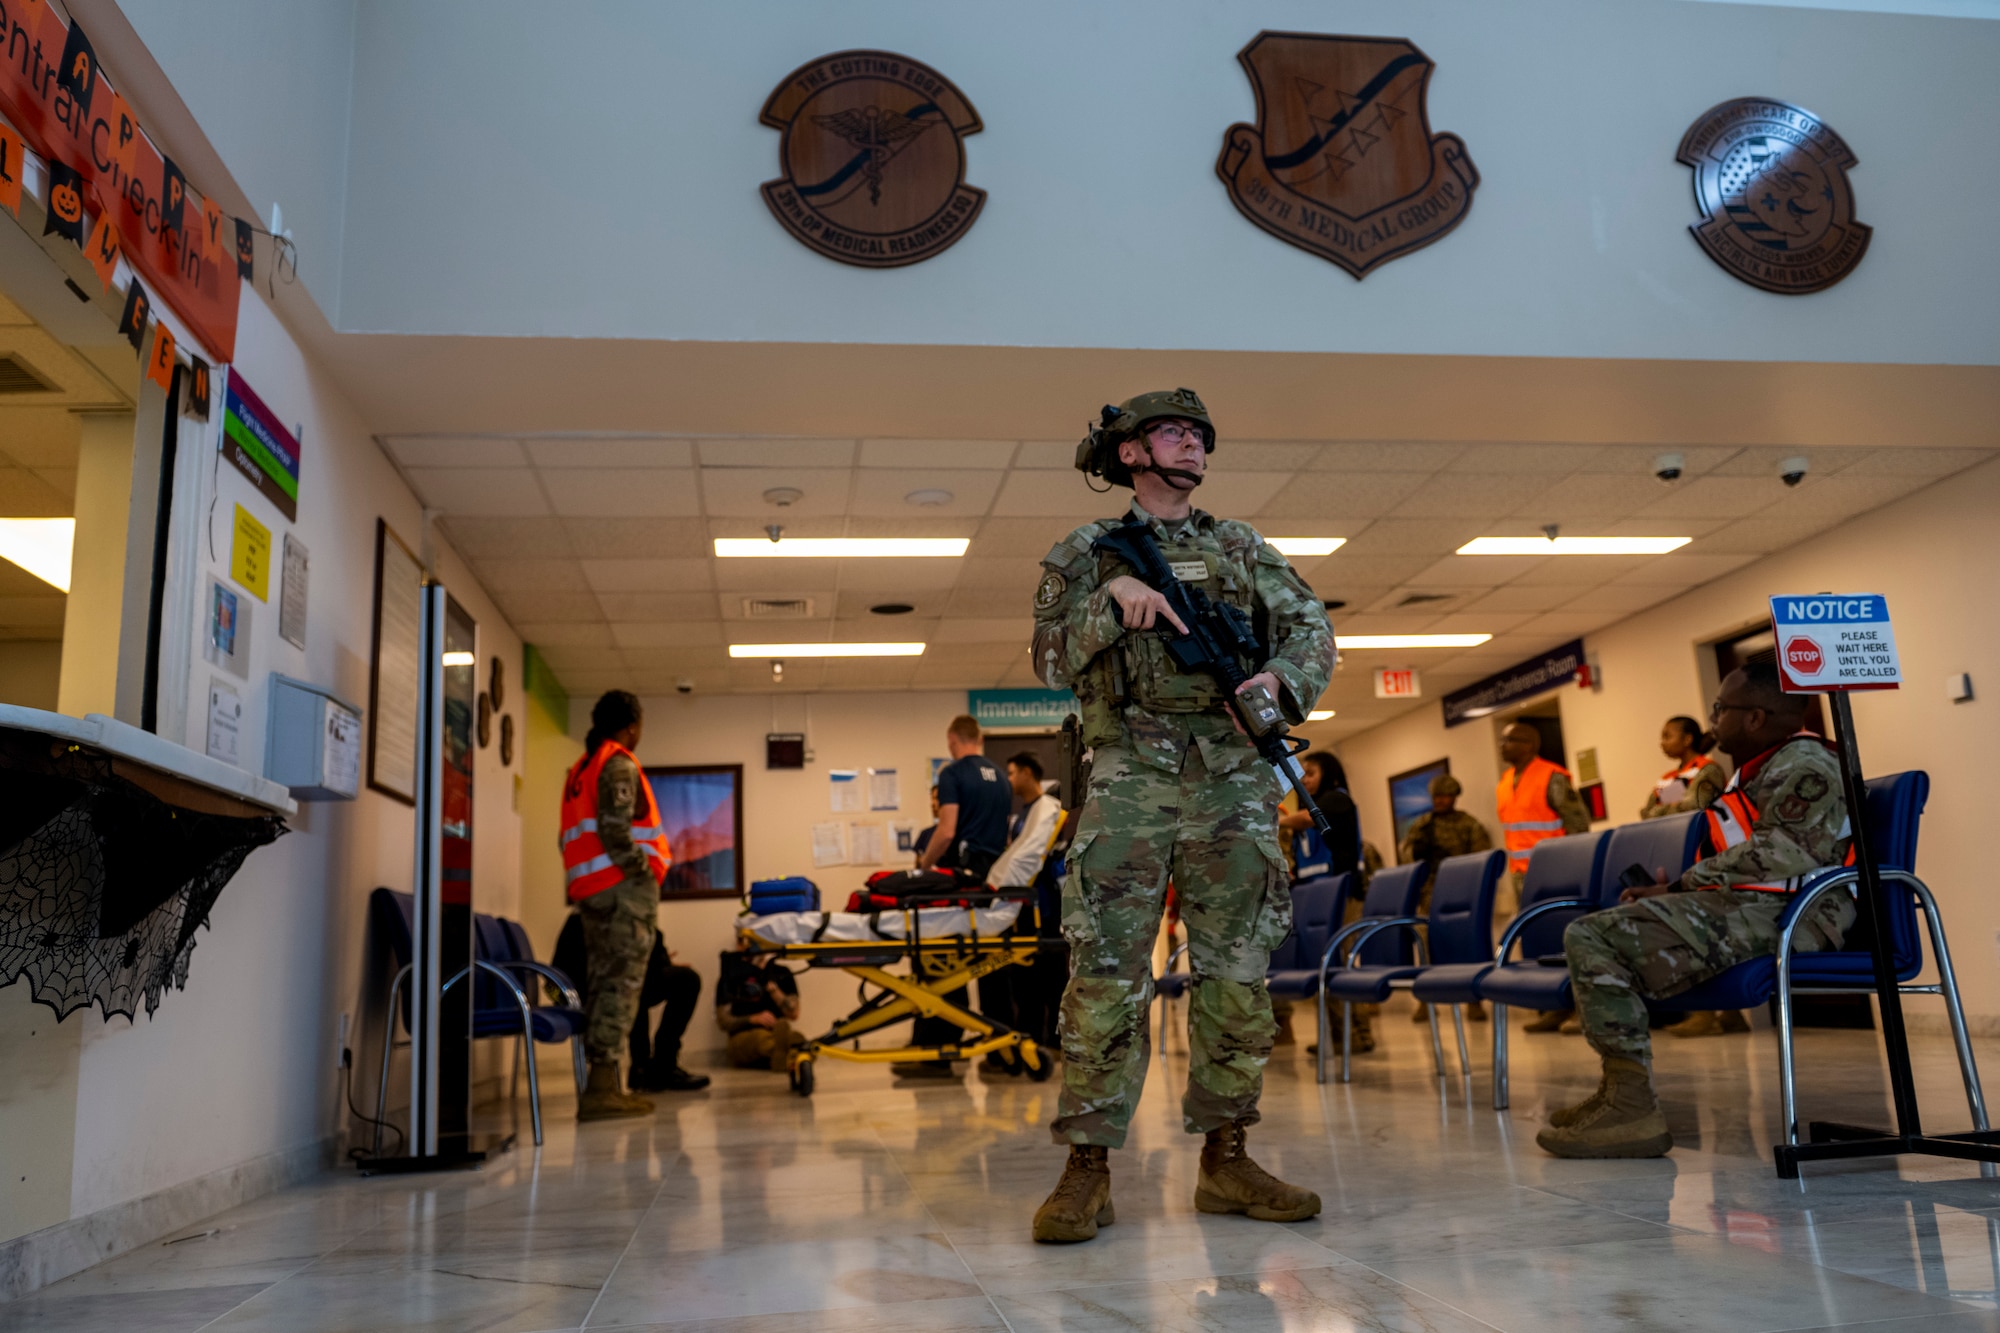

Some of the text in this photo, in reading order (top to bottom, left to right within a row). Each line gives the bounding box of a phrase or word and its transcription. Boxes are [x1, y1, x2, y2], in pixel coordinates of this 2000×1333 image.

[798, 58, 946, 98] THE CUTTING EDGE
[801, 215, 821, 232] OP
[821, 226, 886, 255] MEDICAL
[889, 210, 961, 254] READINESS
[951, 194, 973, 214] SQ
[1297, 206, 1398, 254] MEDICAL
[1398, 182, 1458, 230] GROUP
[1763, 266, 1788, 283] AIR
[1790, 266, 1826, 284] BASE
[1788, 600, 1873, 620] NOTICE
[1841, 631, 1878, 641] PLEASE
[1789, 651, 1819, 662] STOP
[1835, 643, 1889, 653] WAIT HERE
[1838, 655, 1891, 665] UNTIL YOU
[1839, 667, 1897, 677] ARE CALLED
[1382, 669, 1413, 694] EXIT
